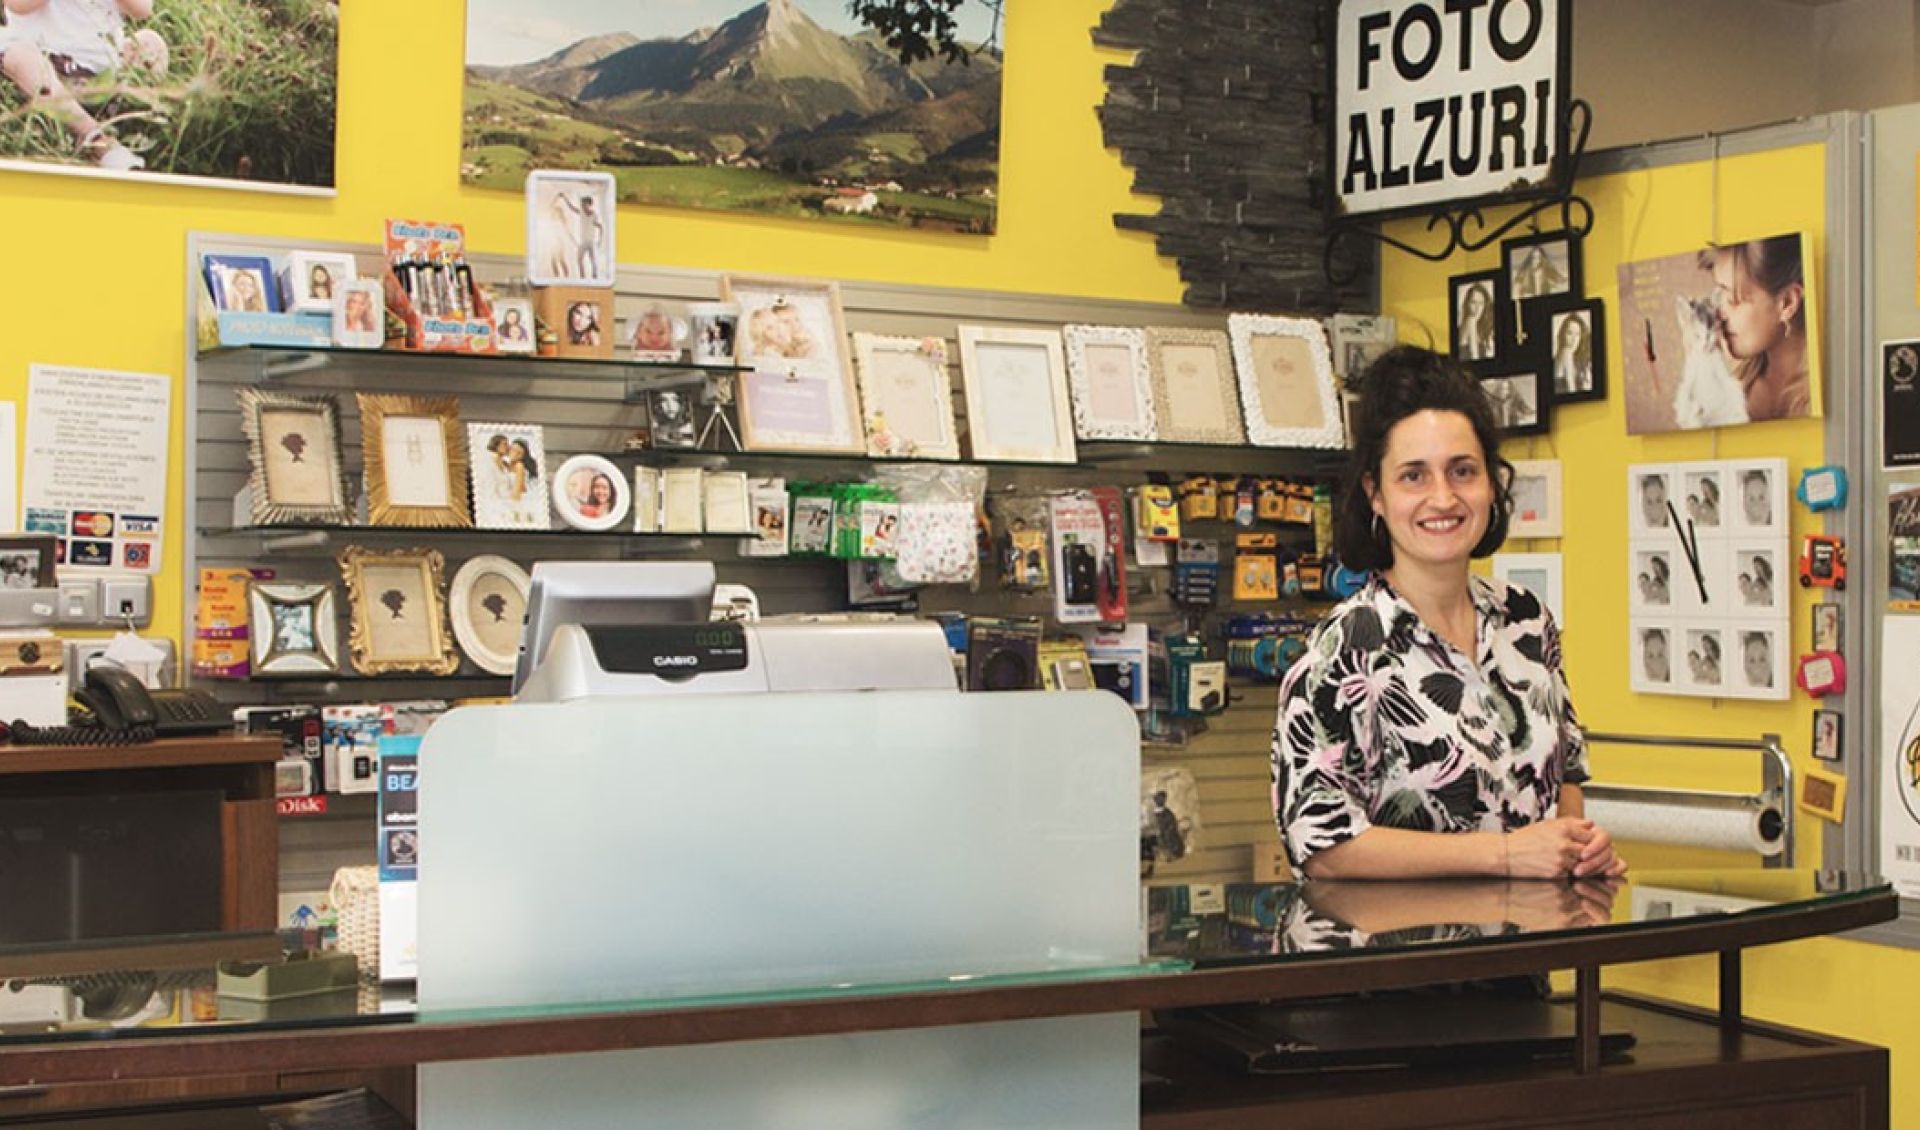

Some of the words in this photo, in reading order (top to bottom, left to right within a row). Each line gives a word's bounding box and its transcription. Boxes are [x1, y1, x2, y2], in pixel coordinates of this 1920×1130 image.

[1358, 0, 1543, 91] FOTO
[1343, 78, 1550, 195] ALZURI
[652, 655, 698, 667] CASIO
